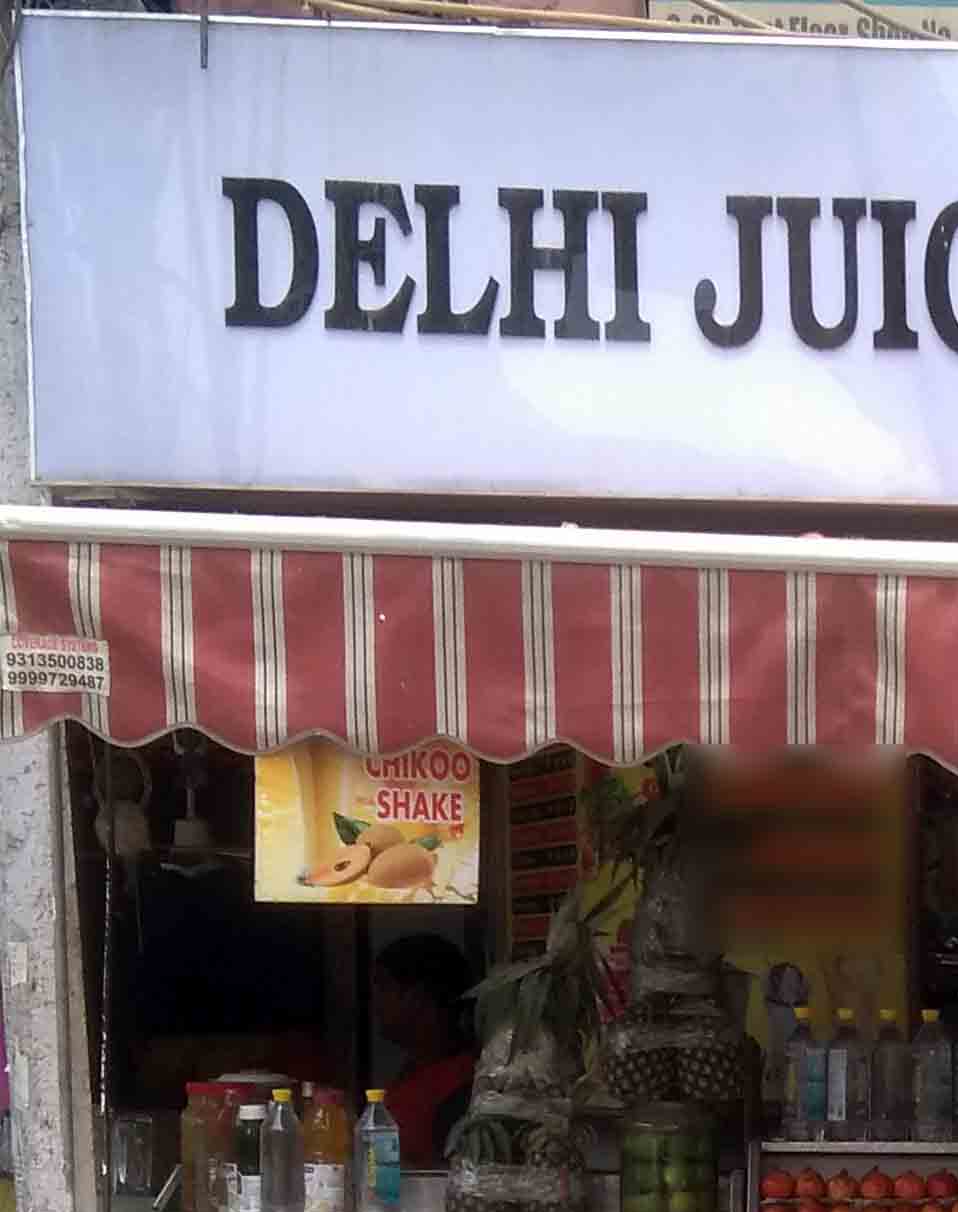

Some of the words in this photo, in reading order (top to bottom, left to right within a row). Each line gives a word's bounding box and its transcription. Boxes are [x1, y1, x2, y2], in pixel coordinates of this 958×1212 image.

[221, 176, 652, 342] DELHI
[6, 652, 105, 671] 9313500838
[7, 671, 105, 691] 9999729487
[376, 788, 463, 821] SHAKE
